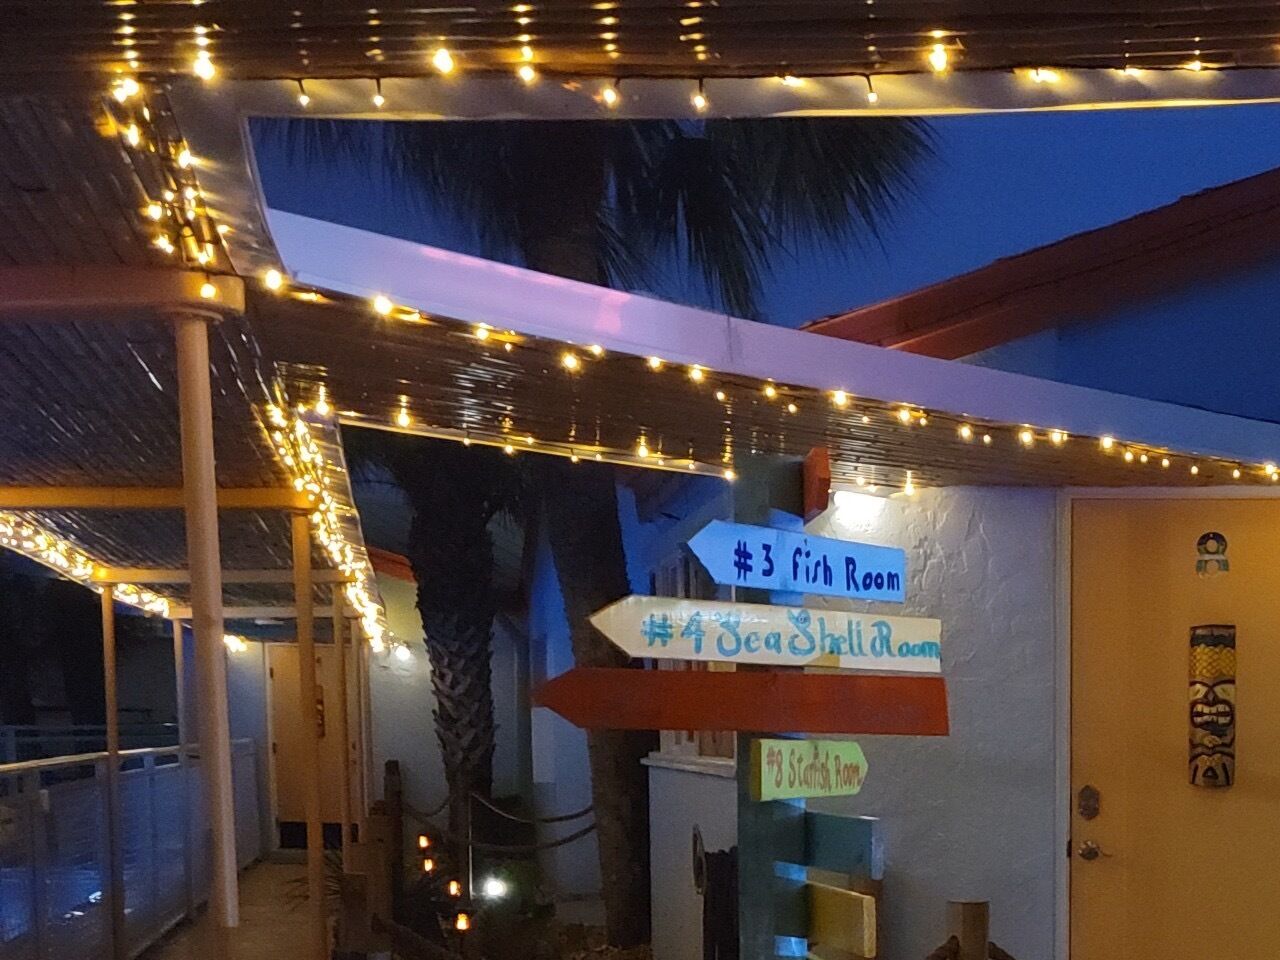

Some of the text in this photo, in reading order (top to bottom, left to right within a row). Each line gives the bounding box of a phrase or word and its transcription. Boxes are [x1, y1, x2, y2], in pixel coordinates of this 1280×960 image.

[845, 555, 901, 592] Room
[716, 610, 782, 657] Sea
[786, 608, 868, 657] Shell
[870, 620, 941, 660] Room
[834, 754, 864, 790] Room
